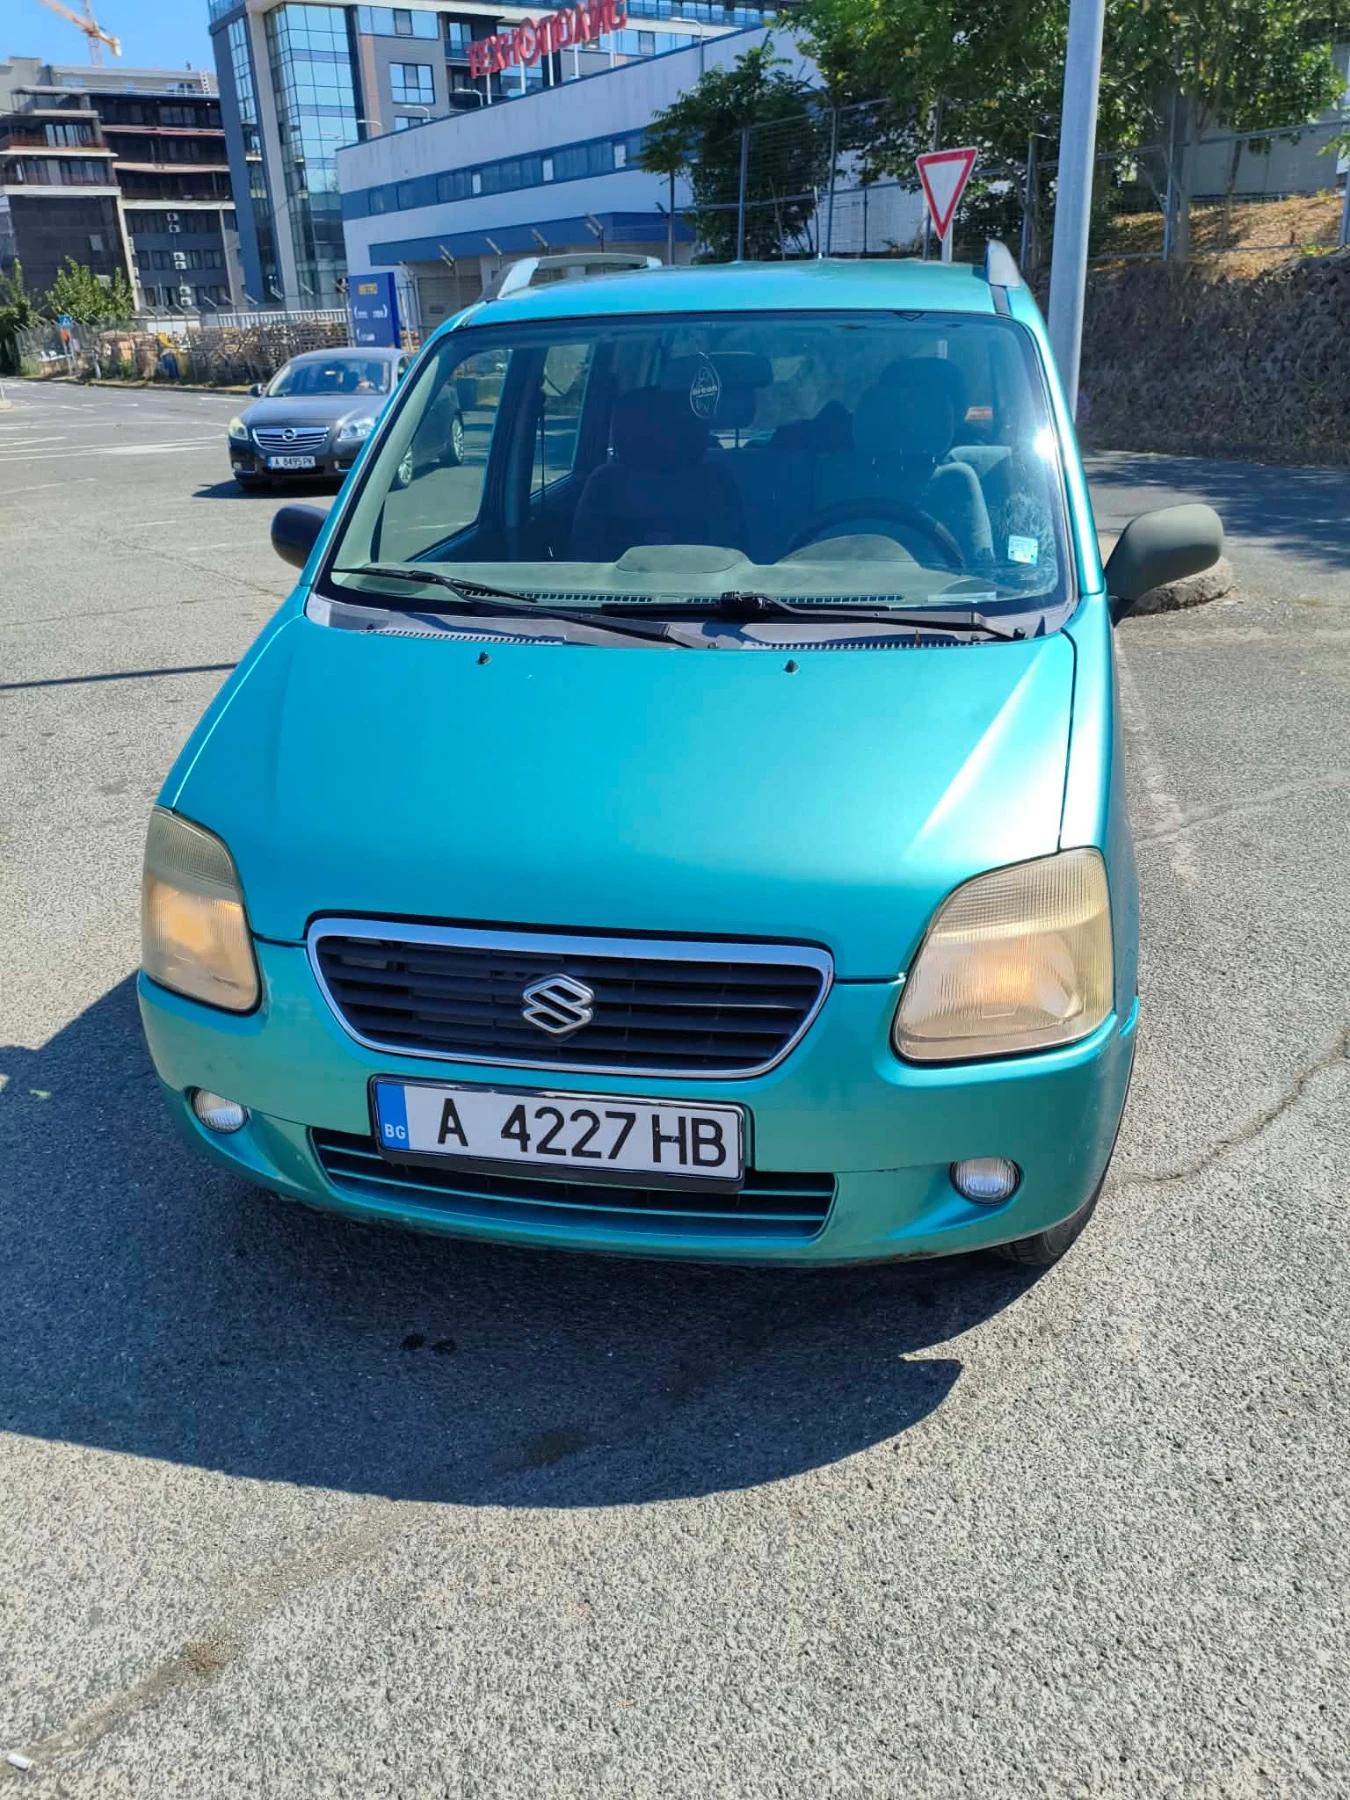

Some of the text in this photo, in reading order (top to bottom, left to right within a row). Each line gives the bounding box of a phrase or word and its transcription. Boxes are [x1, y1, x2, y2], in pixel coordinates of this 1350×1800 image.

[384, 1122, 407, 1140] BG
[437, 1097, 727, 1168] A 4227 HB
